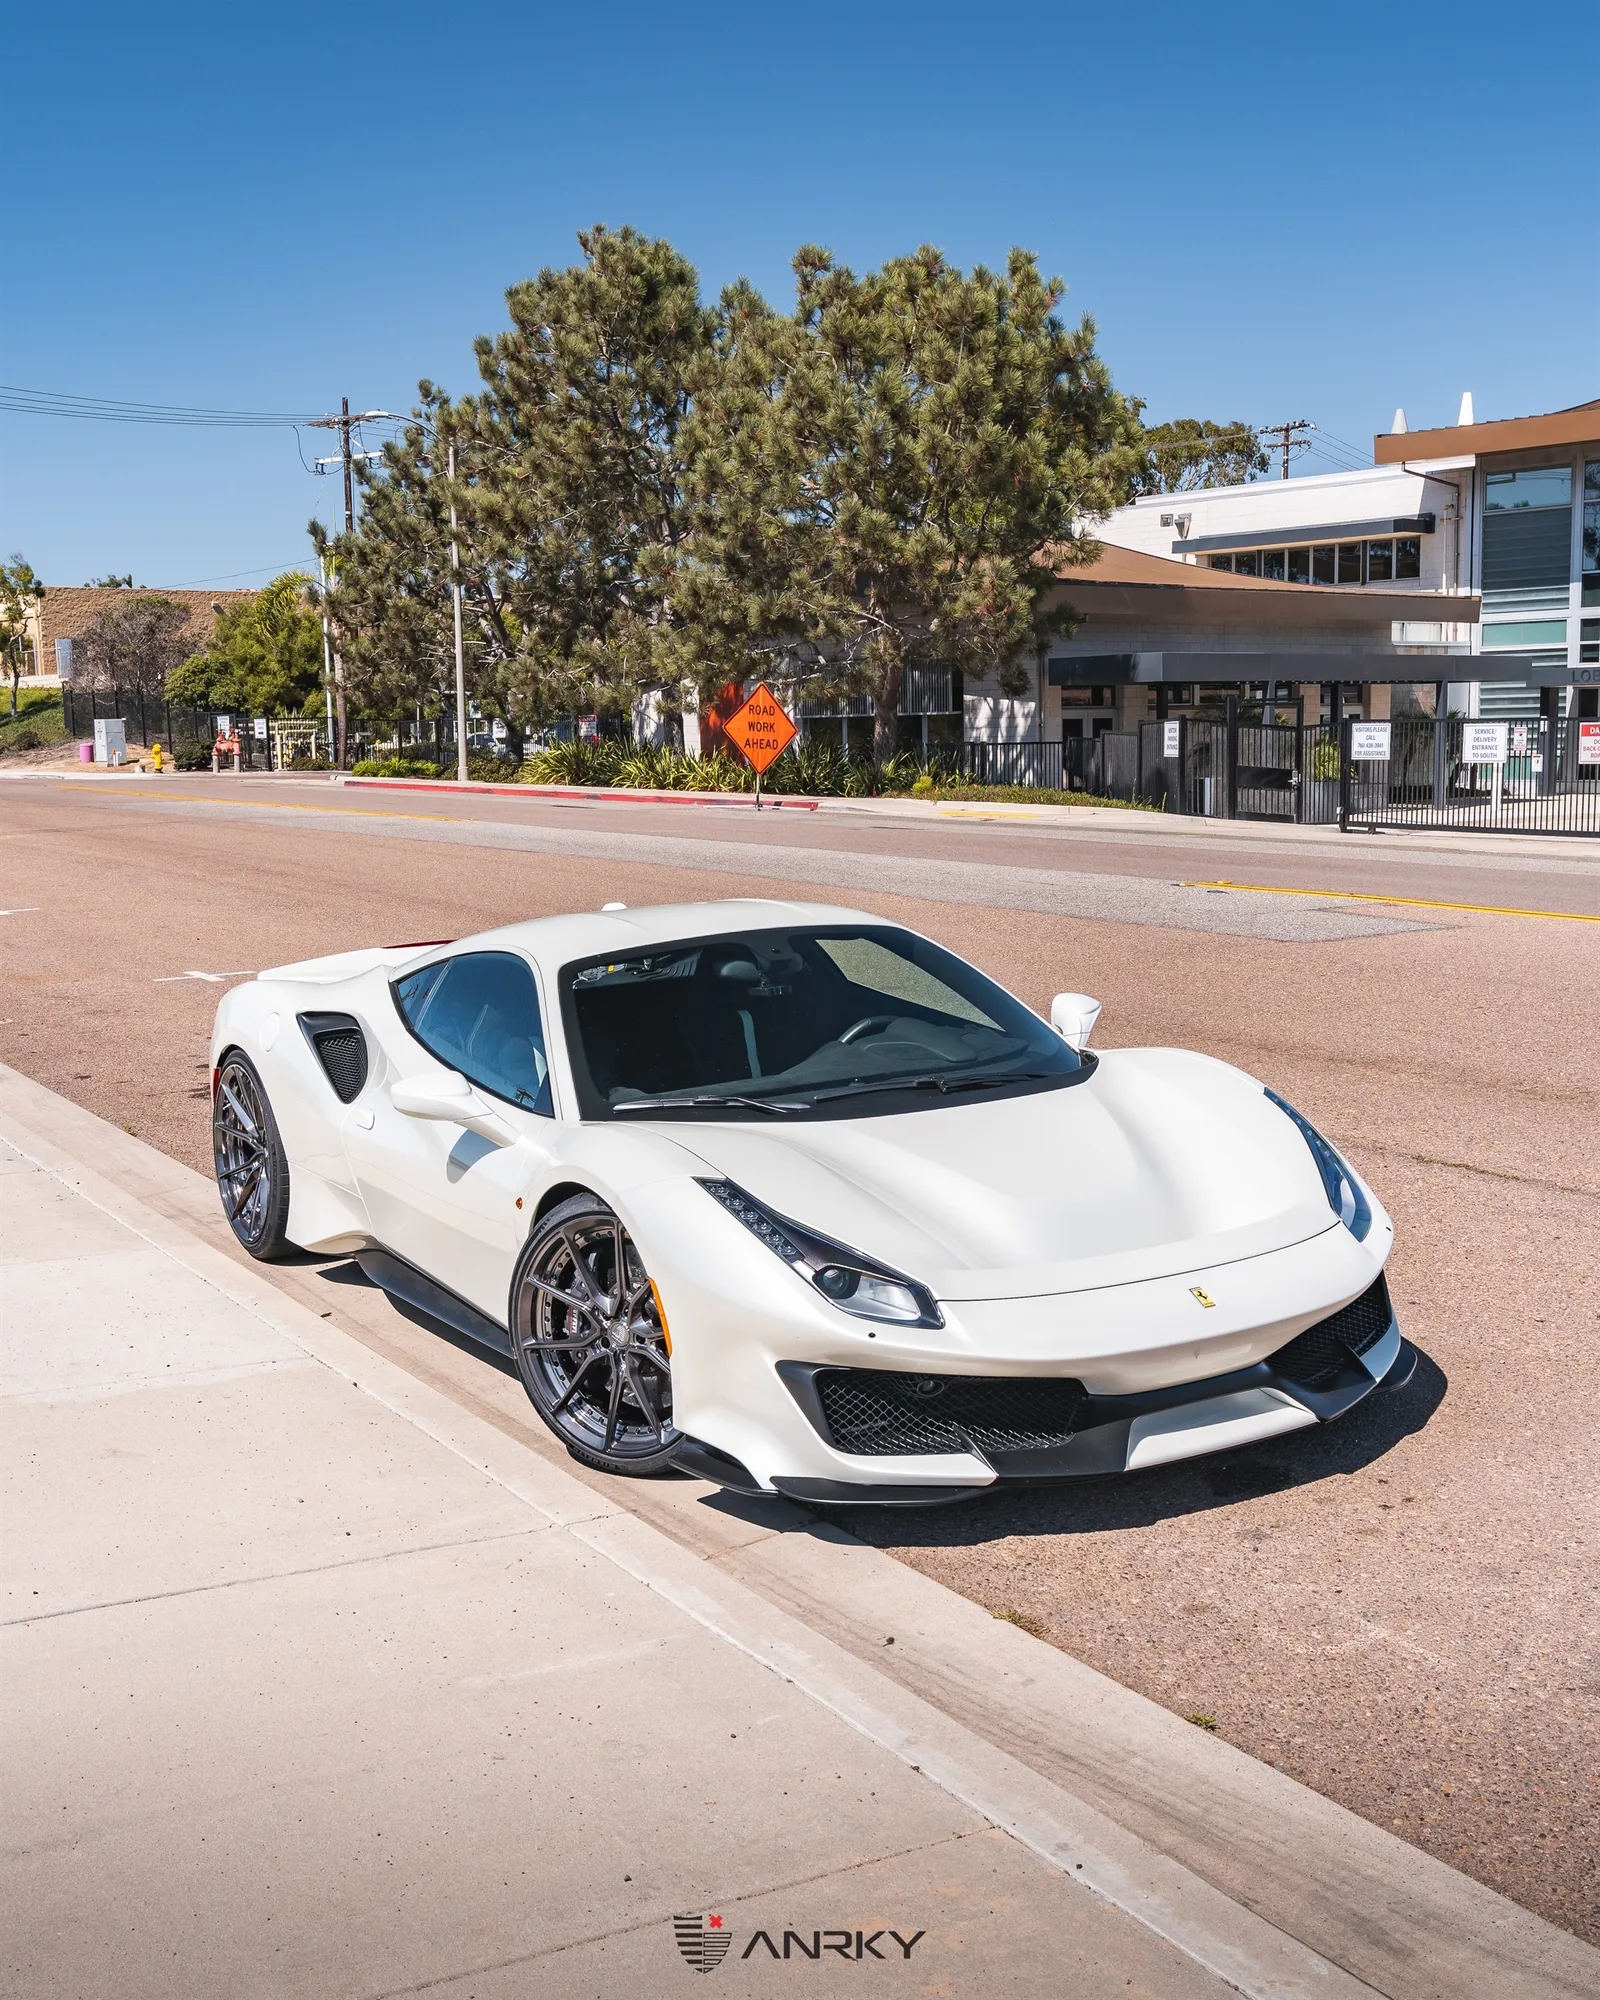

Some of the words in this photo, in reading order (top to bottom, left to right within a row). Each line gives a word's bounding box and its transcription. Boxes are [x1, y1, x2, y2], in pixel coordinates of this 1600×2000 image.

[748, 704, 776, 716] ROAD
[747, 721, 776, 733] WORK
[743, 738, 779, 750] AHEAD
